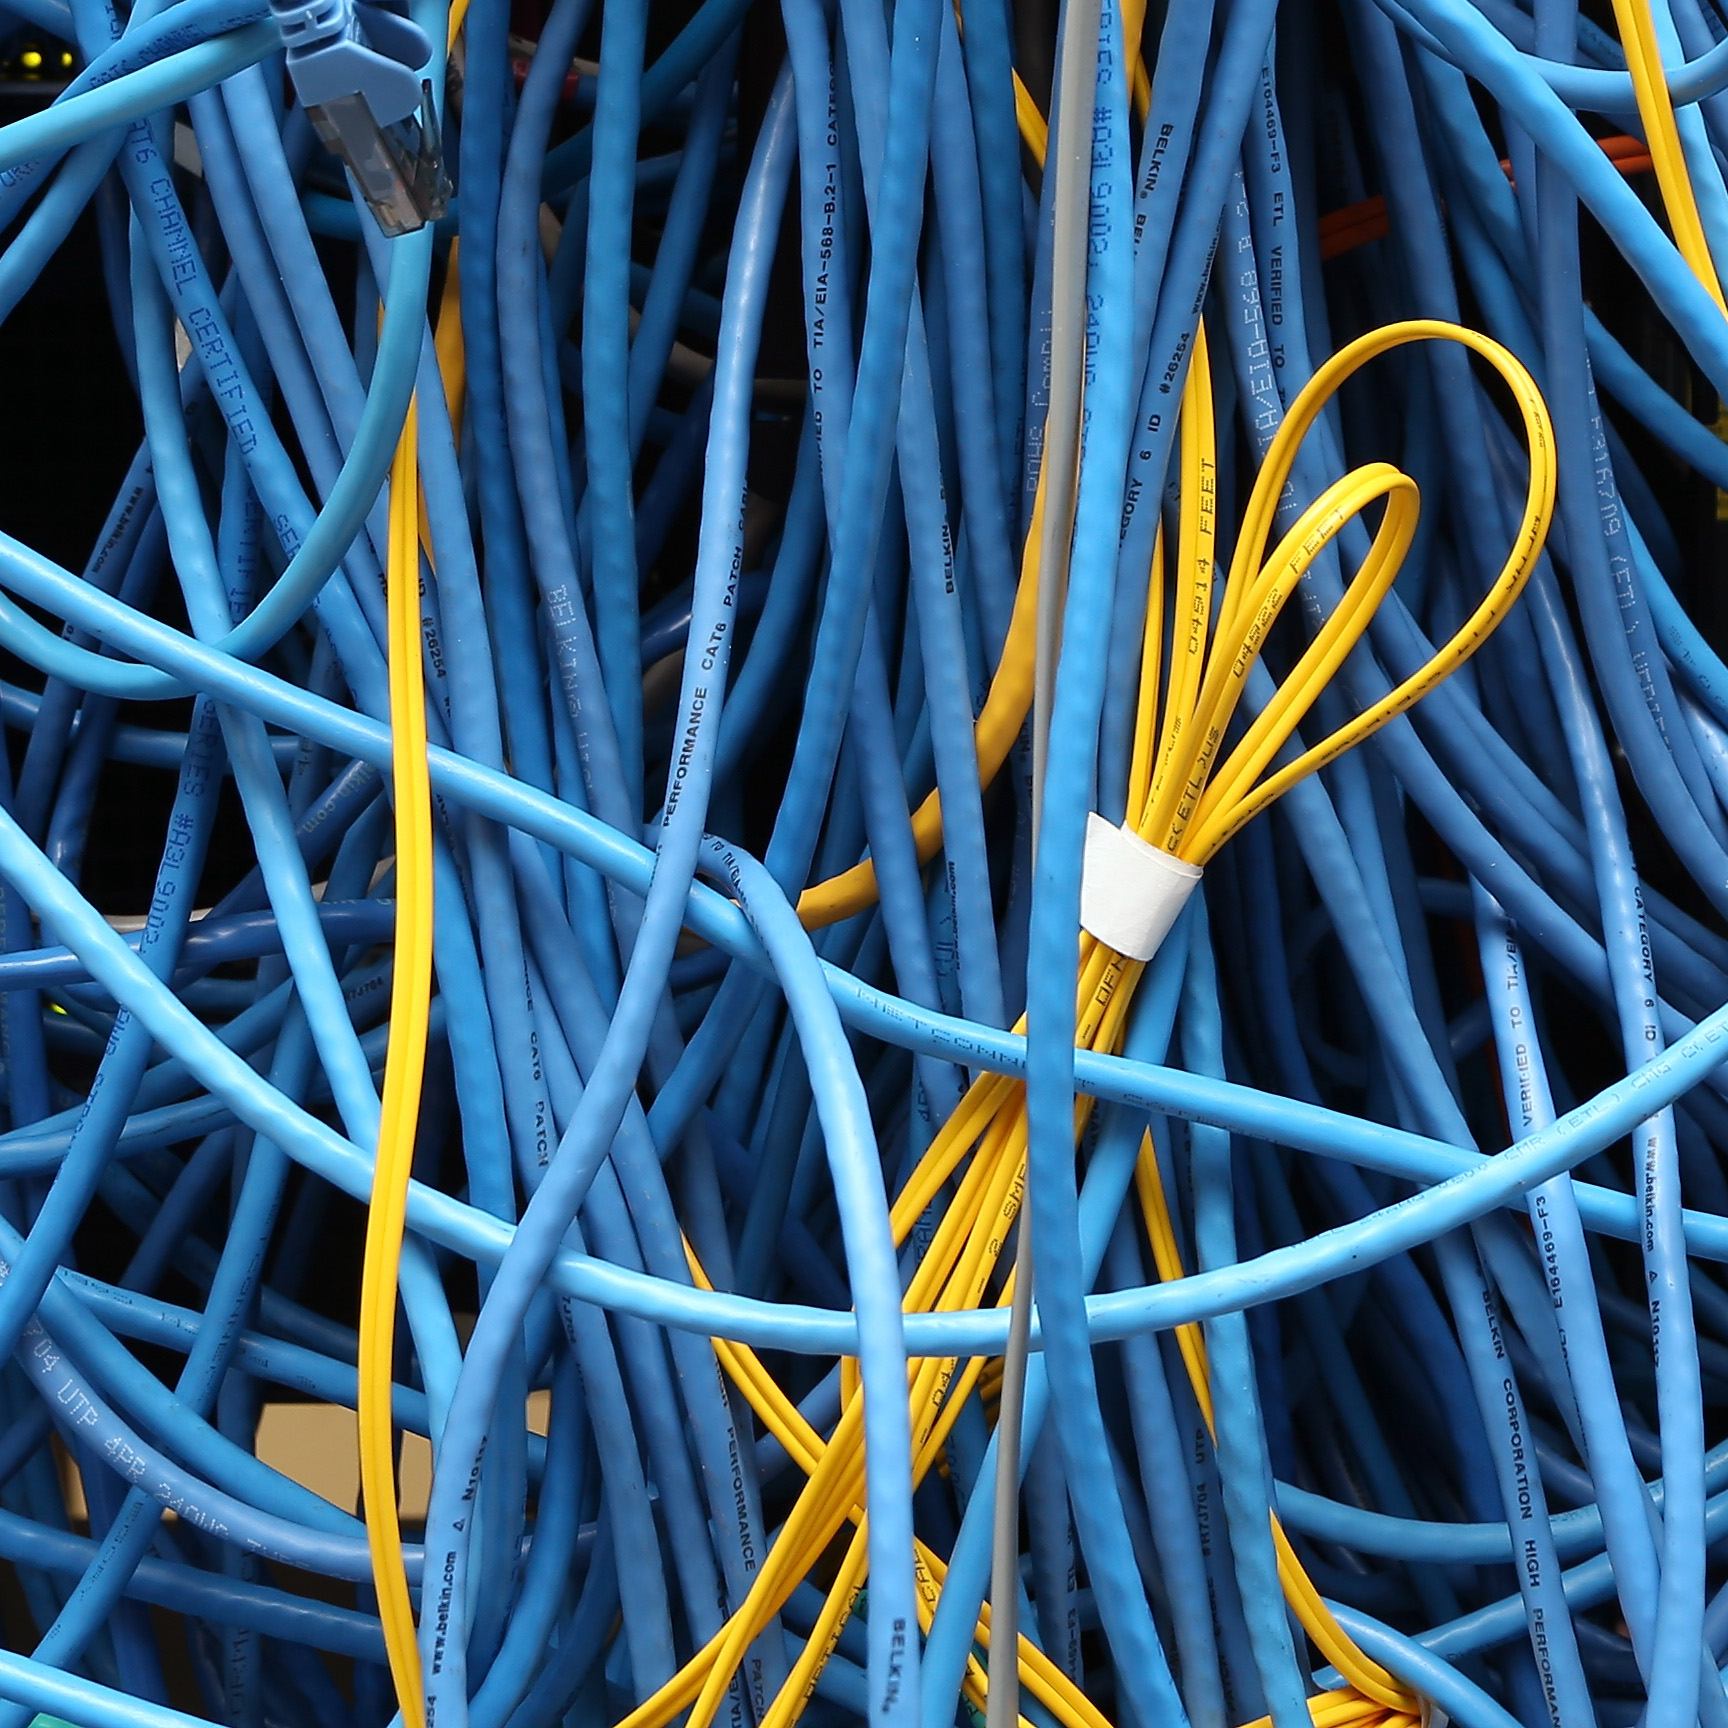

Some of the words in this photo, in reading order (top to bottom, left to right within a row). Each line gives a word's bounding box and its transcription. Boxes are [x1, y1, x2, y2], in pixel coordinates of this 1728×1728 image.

[153, 178, 192, 295] CHANNEL
[812, 160, 837, 348] TIA/EIA-568-B.2-1
[1273, 192, 1285, 227] ETL
[1270, 246, 1285, 325] VERIFIED
[812, 371, 824, 394] TO
[1273, 345, 1284, 367] TO
[1200, 459, 1214, 535] FEET
[663, 688, 709, 827] PERFORMANCE
[702, 621, 727, 672] CAT6
[1633, 885, 1653, 983] CATEGORY
[1510, 1007, 1522, 1028] TO
[1643, 999, 1653, 1009] 6
[1643, 1023, 1654, 1042] ID
[1515, 1042, 1534, 1126] VERIFIED
[1645, 1136, 1657, 1251] www.belkin.com
[1536, 1195, 1563, 1308] E164469-F3
[1480, 1290, 1504, 1360] BELKIN
[1502, 1378, 1532, 1518] CORPORATION
[1525, 1540, 1541, 1587] HIGH
[726, 1427, 758, 1573] PERFORMANCE
[431, 1550, 457, 1675] www.belkin.com
